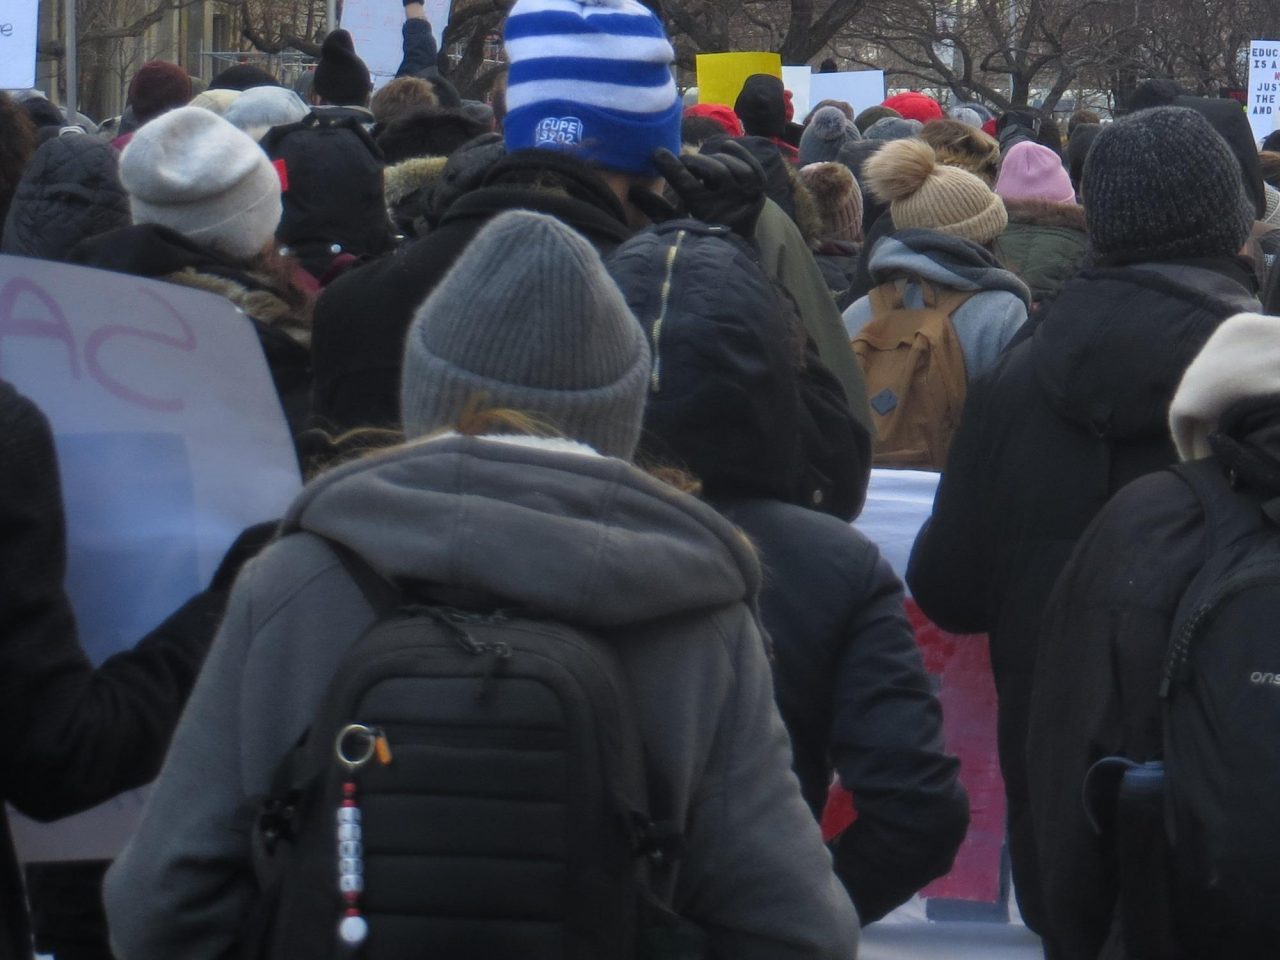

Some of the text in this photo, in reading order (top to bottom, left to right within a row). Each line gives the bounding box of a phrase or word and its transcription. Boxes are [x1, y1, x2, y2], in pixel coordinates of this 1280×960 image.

[1254, 60, 1267, 69] IS
[1271, 60, 1277, 69] A
[1256, 95, 1275, 104] THE
[1252, 106, 1272, 115] AND
[541, 118, 578, 134] CUPE
